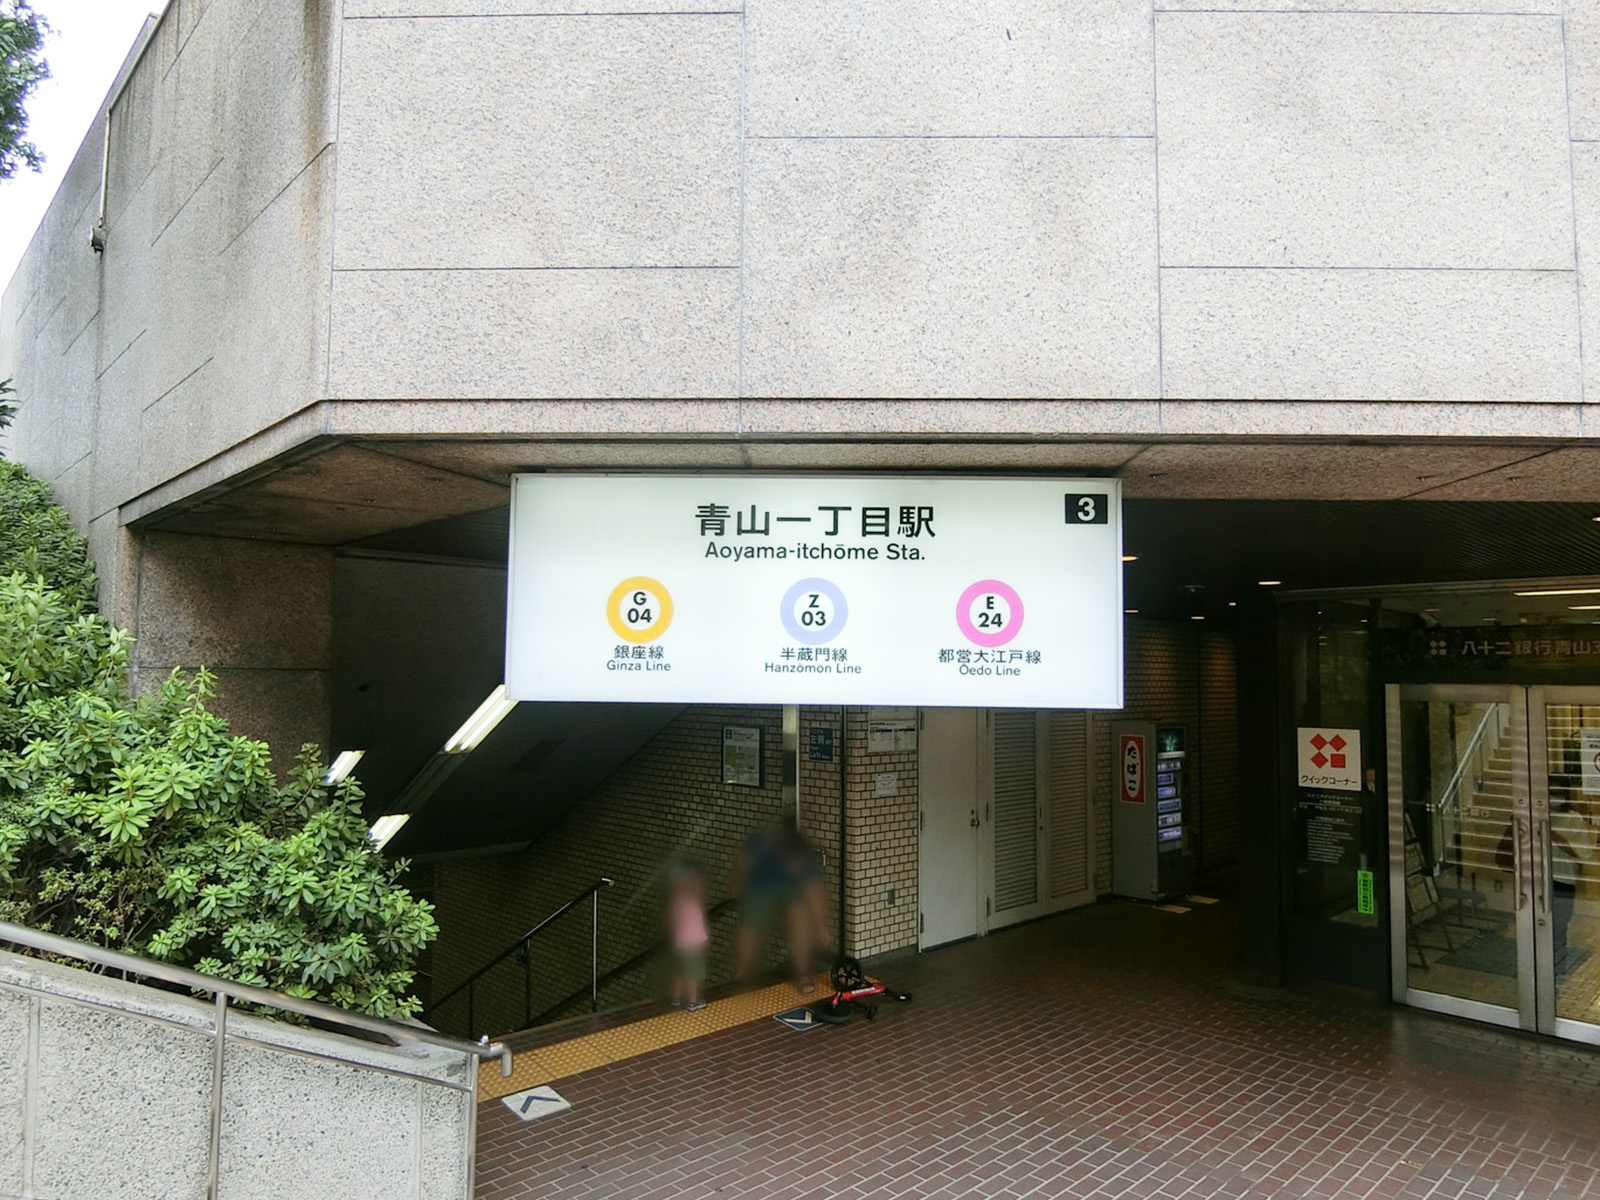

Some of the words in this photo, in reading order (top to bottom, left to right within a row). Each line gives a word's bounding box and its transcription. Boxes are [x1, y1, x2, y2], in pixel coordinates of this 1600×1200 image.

[1077, 497, 1096, 522] 3
[694, 503, 936, 538] 青山一丁目駅
[705, 541, 879, 562] Aoyama-itchōme
[886, 542, 925, 561] Sta.
[633, 592, 647, 606] G
[808, 594, 820, 608] Z
[985, 596, 996, 610] E
[627, 607, 652, 623] 04
[801, 610, 826, 626] 03
[978, 612, 1003, 628] 24
[614, 645, 664, 660] 銀座線
[780, 647, 848, 662] 半蔵門線
[938, 648, 1042, 664] 都営大江戸線
[606, 660, 642, 672] Ginza
[646, 660, 671, 672] Line
[836, 663, 862, 674] Line
[996, 665, 1021, 676] Line
[1127, 746, 1139, 791] たばこ
[1301, 775, 1358, 786] クイックコーナー
